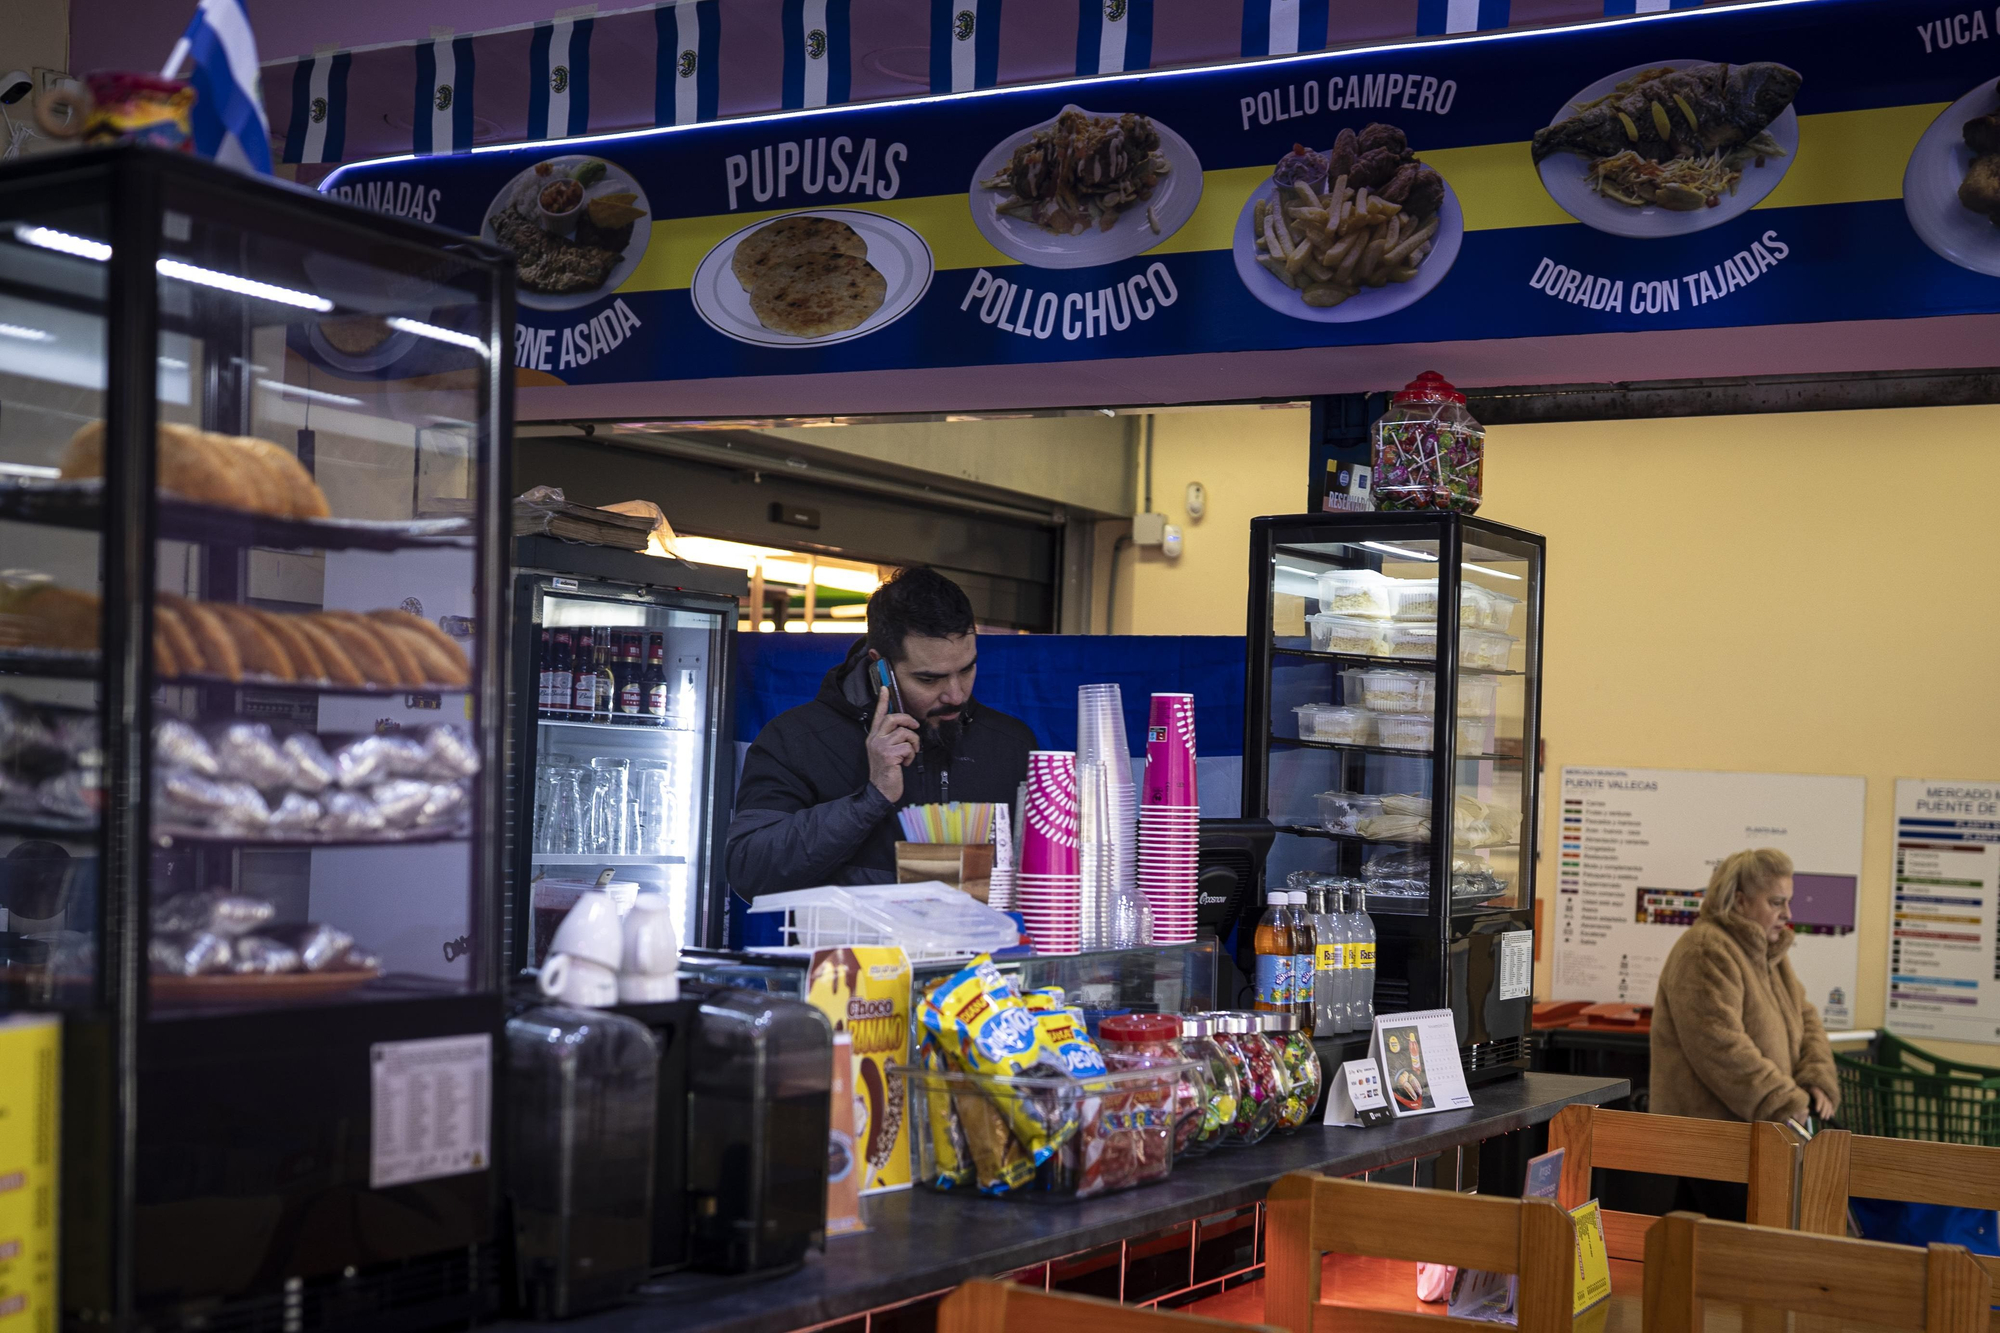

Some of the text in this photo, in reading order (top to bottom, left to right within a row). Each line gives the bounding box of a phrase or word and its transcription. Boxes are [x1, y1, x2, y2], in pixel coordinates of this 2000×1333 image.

[1917, 10, 1989, 53] YUCA
[1240, 73, 1458, 131] POLLO CAMPERO
[725, 135, 908, 211] PUPUSAS
[1528, 229, 1790, 314] DORADA CON TAJADAS
[960, 261, 1179, 341] POLLO CHUCO
[559, 298, 642, 370] ASADA
[1565, 778, 1658, 791] PUENTE VALLECAS
[1916, 799, 1997, 815] PUENTE DE
[1926, 787, 1992, 801] MERCADO
[846, 997, 894, 1020] Choco
